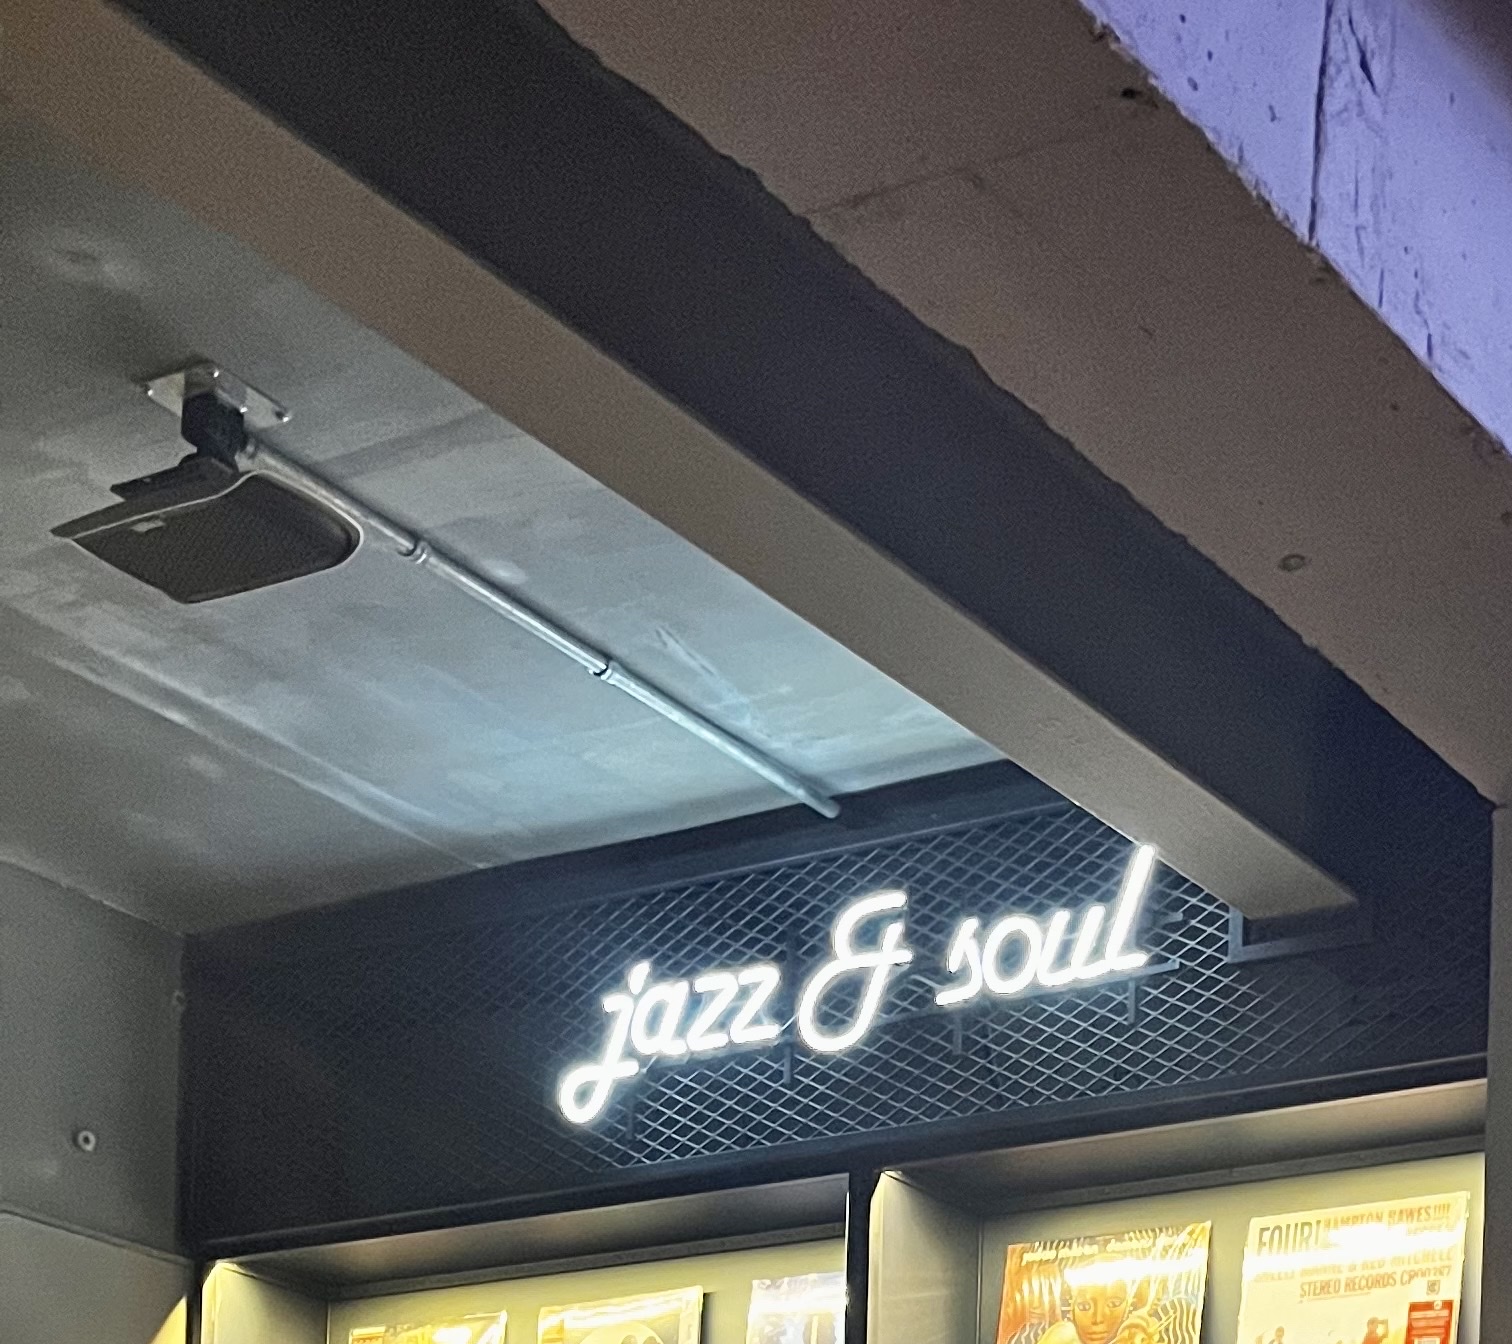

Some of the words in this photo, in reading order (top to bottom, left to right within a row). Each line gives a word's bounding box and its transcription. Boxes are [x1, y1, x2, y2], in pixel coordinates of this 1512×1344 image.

[559, 959, 781, 1123] jazz
[799, 890, 913, 1052] &
[935, 843, 1157, 1006] soul
